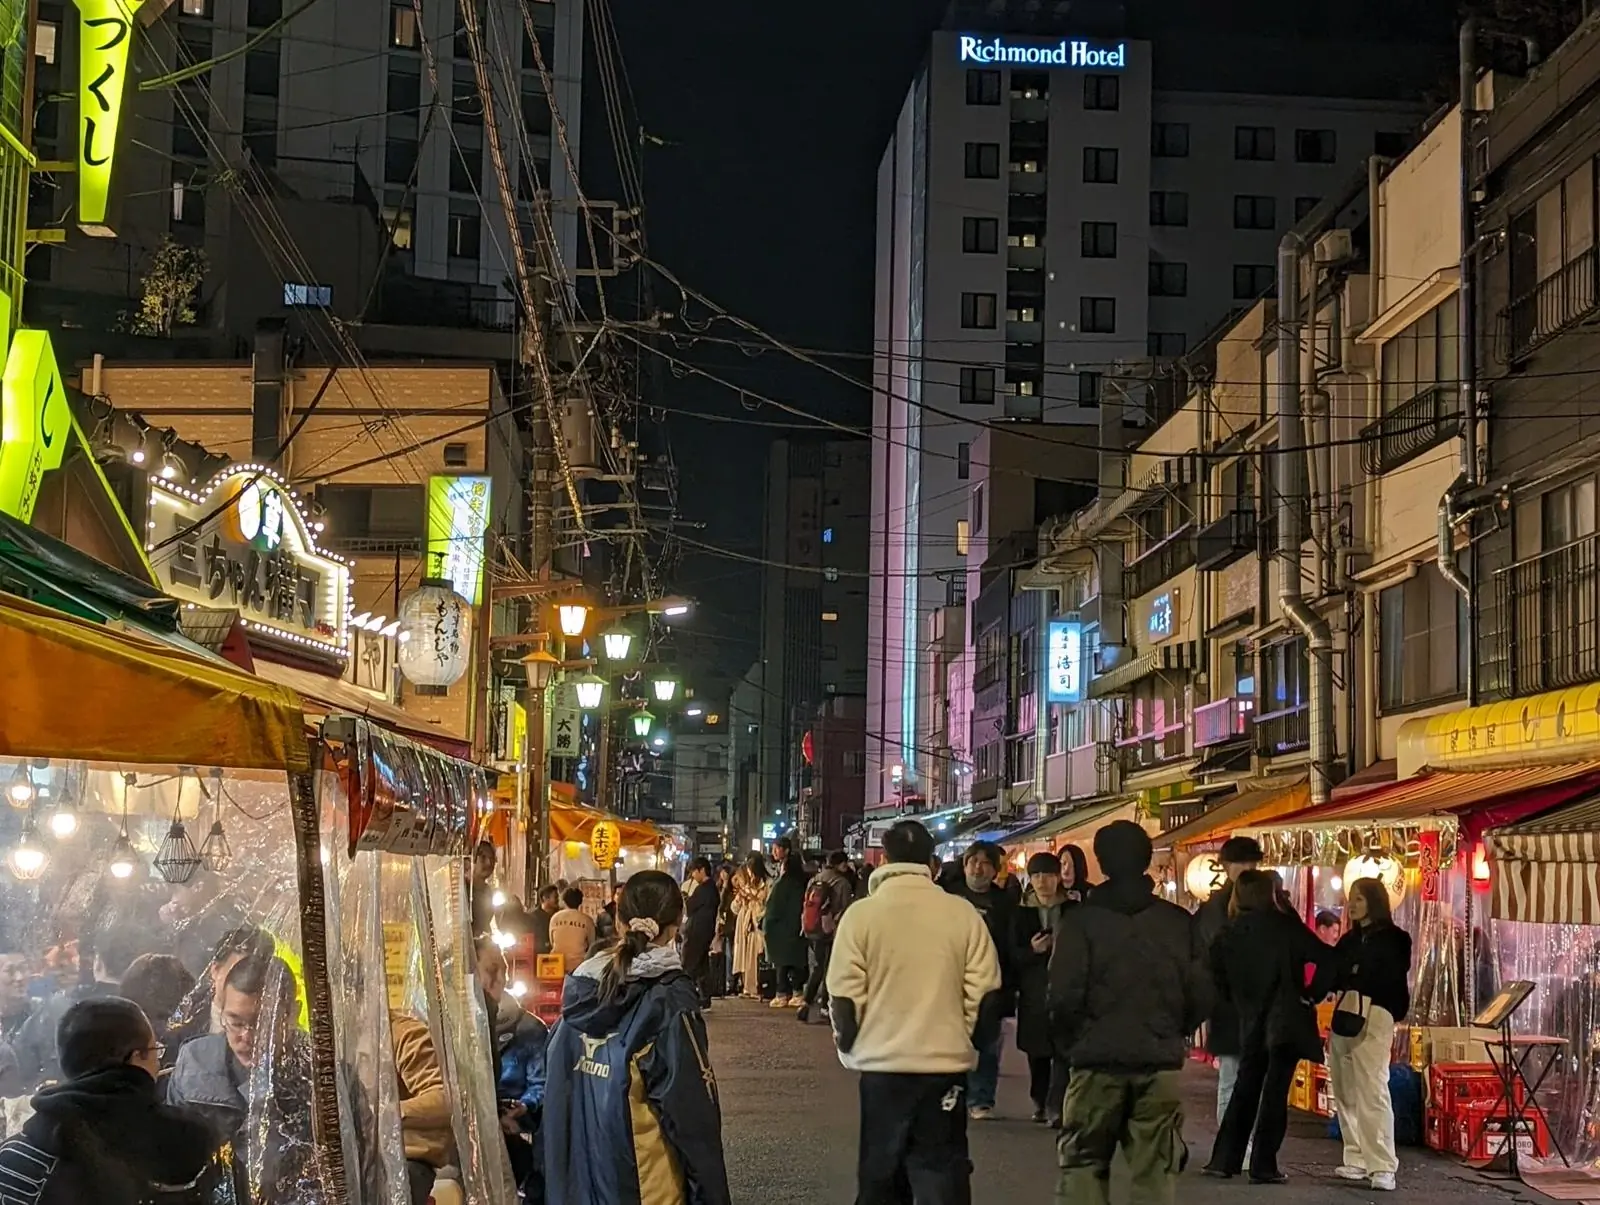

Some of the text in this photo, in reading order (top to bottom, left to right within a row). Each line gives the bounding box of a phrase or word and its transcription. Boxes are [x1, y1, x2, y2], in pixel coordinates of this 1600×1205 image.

[960, 36, 1125, 67] Richmond Hotel
[83, 17, 127, 166] つくし
[1057, 655, 1073, 690] 浩司
[557, 718, 571, 749] 大勝
